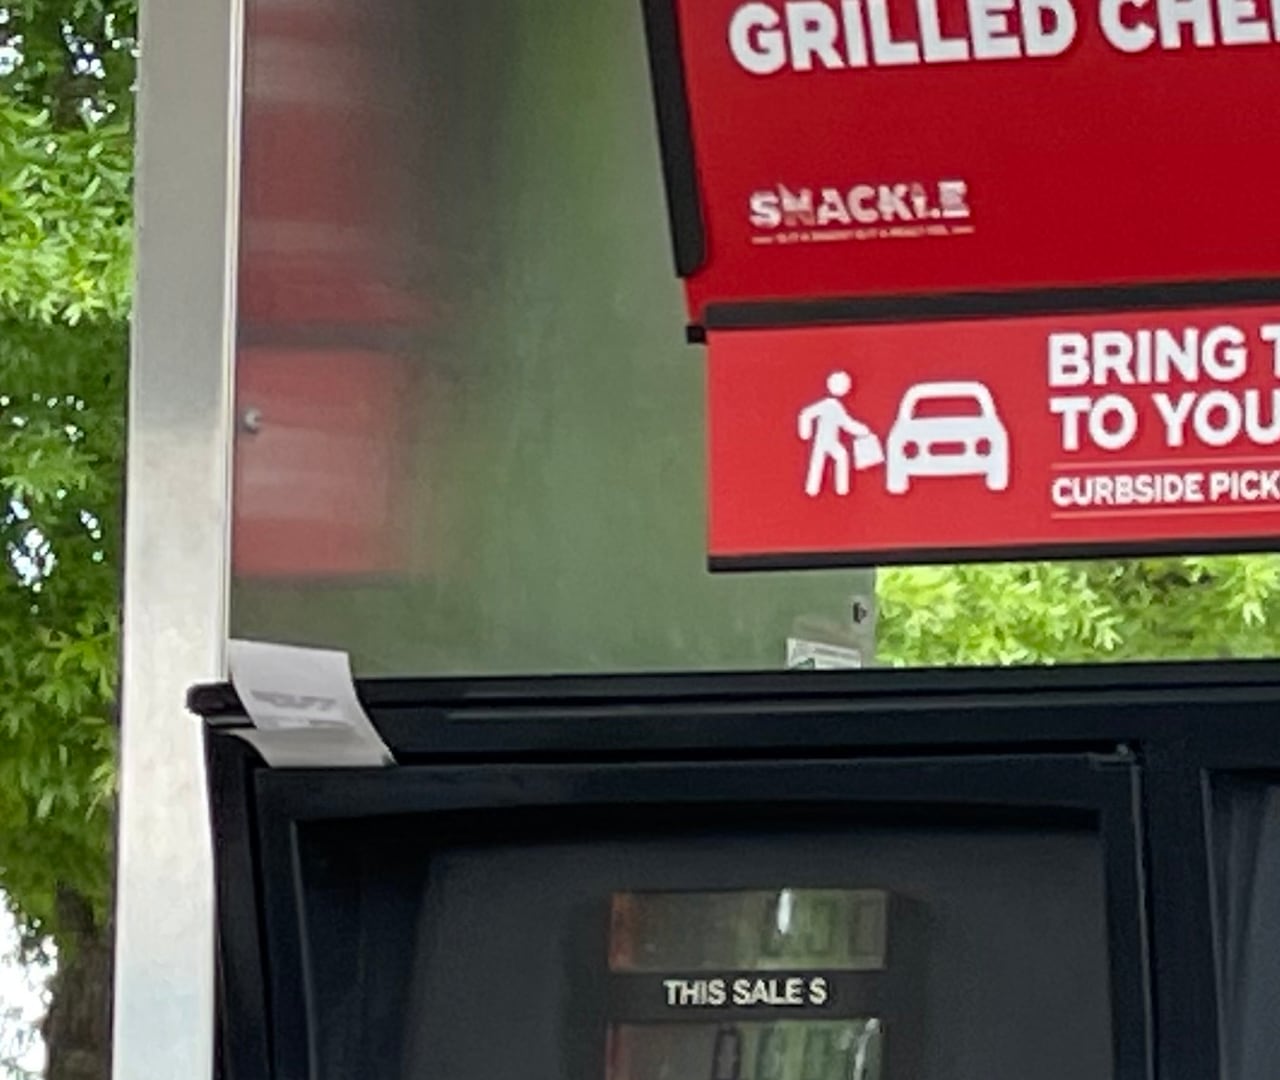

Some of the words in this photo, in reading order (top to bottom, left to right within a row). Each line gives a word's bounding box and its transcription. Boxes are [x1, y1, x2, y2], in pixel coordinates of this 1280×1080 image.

[729, 0, 1077, 74] GRILLED
[1048, 326, 1247, 387] BRING
[1049, 395, 1138, 450] TO
[1051, 473, 1205, 506] CURBSIDE
[663, 979, 726, 1005] THIS
[733, 978, 804, 1005] SALE
